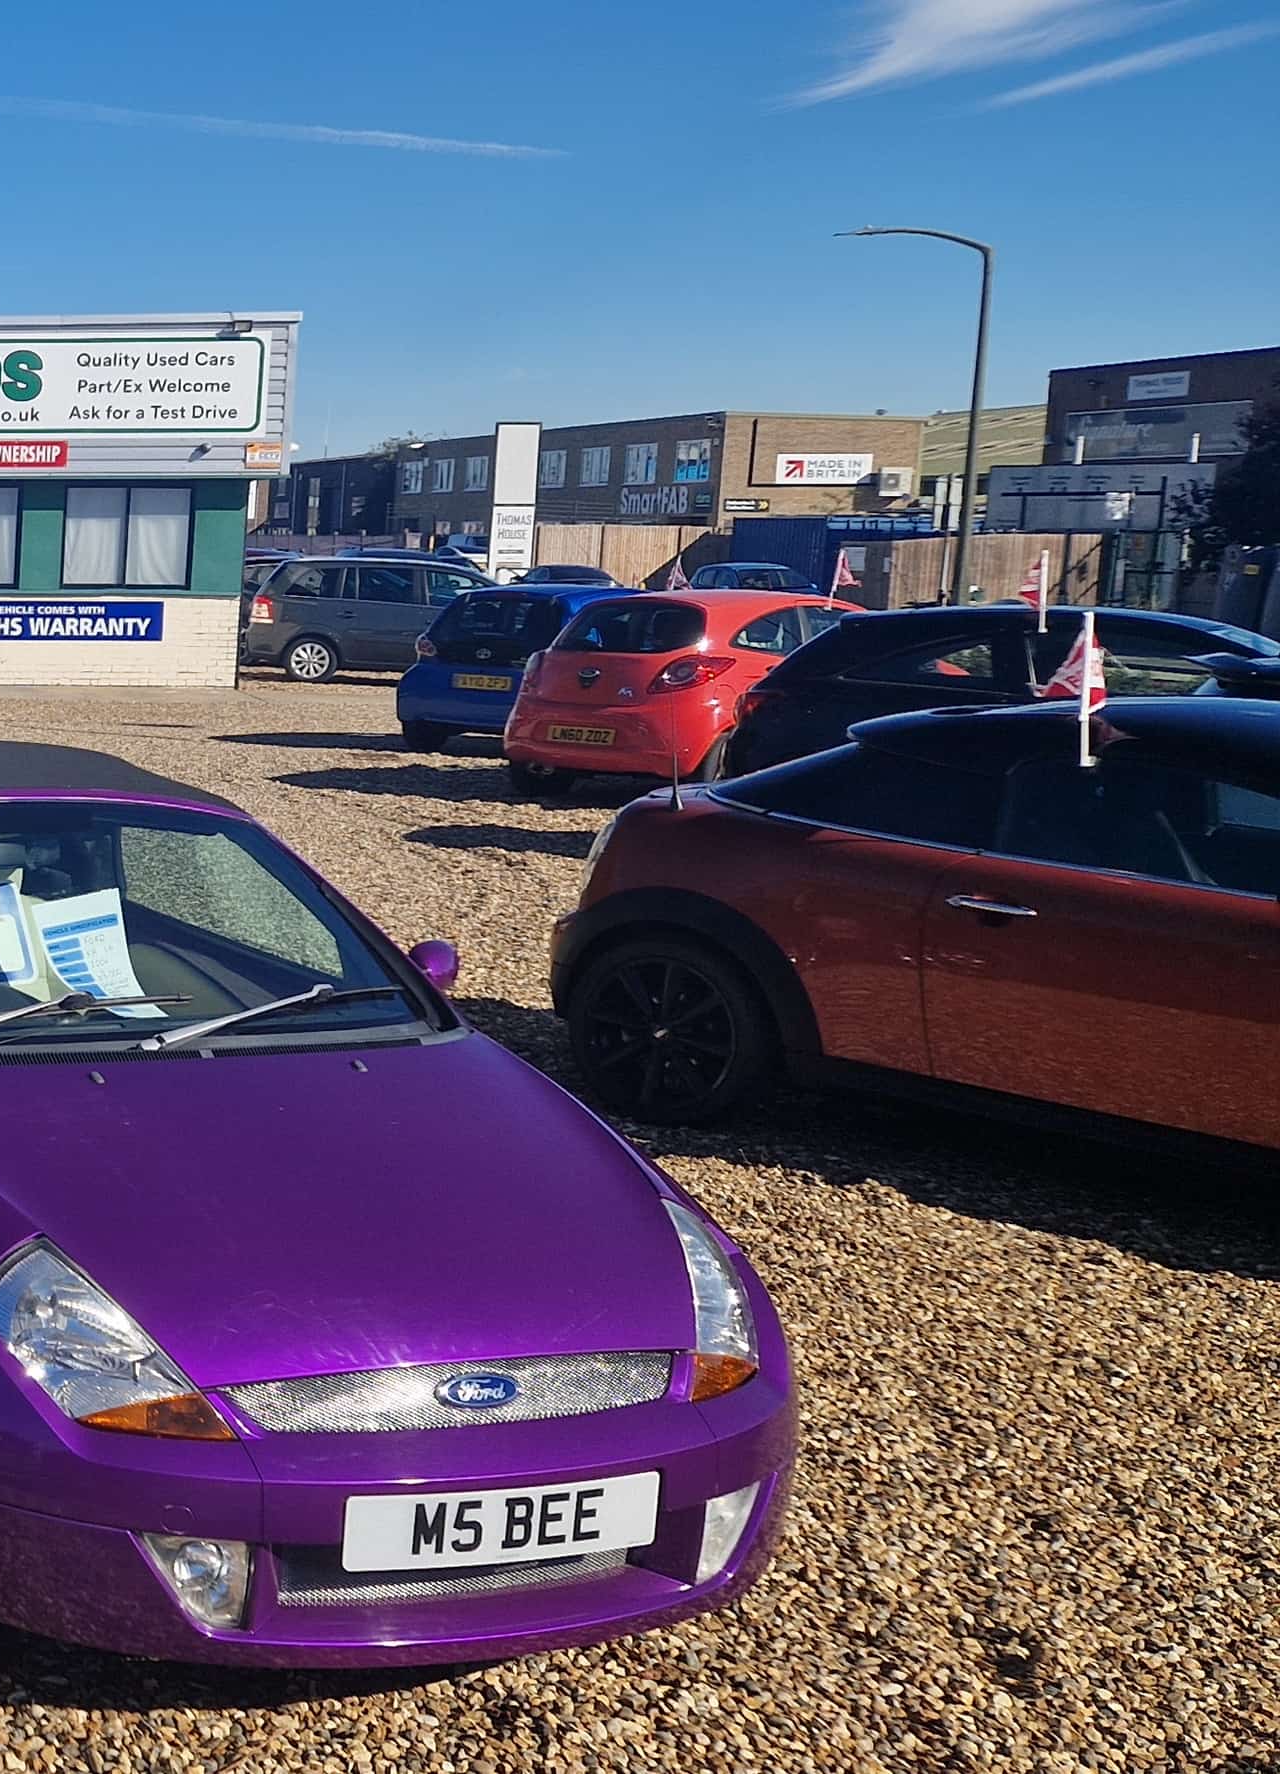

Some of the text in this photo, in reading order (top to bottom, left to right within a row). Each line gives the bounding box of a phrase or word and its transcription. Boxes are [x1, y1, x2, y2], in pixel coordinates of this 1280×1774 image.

[77, 352, 236, 370] Quality Used Cars
[77, 378, 231, 394] Part/Ex Welcome
[69, 404, 238, 420] Ask for a Test Drive
[807, 460, 862, 468] MADE IN
[807, 469, 860, 478] BRITAIN
[620, 486, 688, 514] SmartFAB
[496, 513, 532, 525] THOMAS
[38, 606, 75, 615] COMES
[78, 606, 105, 615] WITH
[30, 618, 151, 636] WARRANTY
[457, 1379, 506, 1402] Ford
[411, 1488, 604, 1555] M5 BEE
